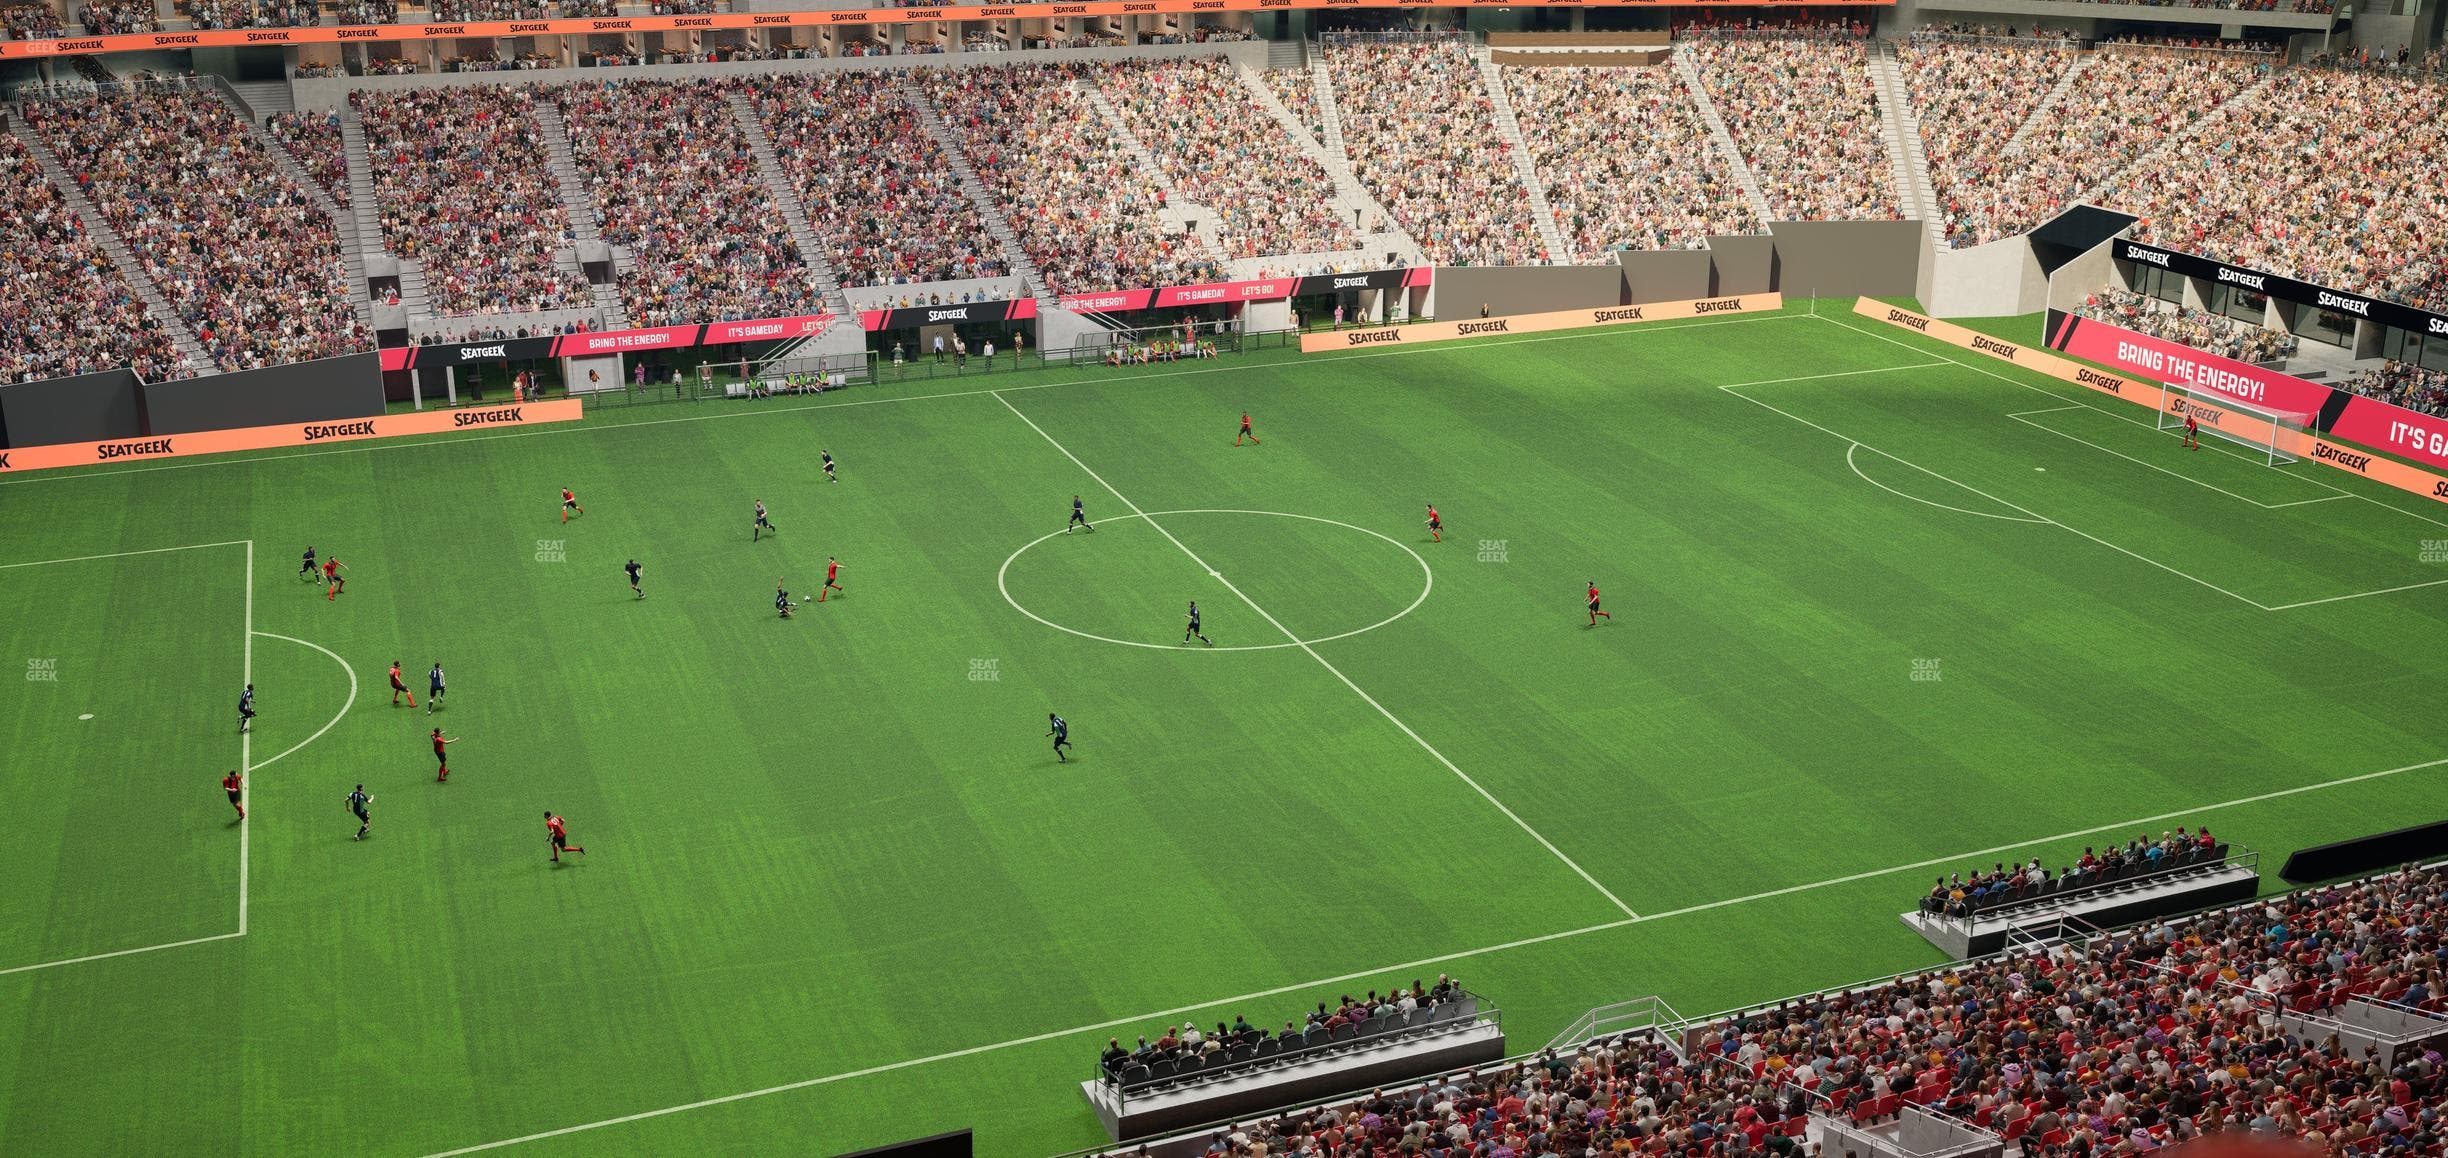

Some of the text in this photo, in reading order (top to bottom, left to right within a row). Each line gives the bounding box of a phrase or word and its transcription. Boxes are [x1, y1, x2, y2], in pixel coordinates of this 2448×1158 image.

[980, 8, 1015, 16] SEATGEEK
[1053, 5, 1087, 13] SEATGEEK
[1123, 3, 1157, 11] SEATGEEK
[1192, 1, 1225, 9] SEATGEEK
[753, 15, 791, 24] SEATGEEK
[831, 13, 867, 21] SEATGEEK
[906, 10, 942, 19] SEATGEEK
[509, 23, 550, 33] SEATGEEK
[593, 20, 632, 30] SEATGEEK
[674, 18, 712, 27] SEATGEEK
[247, 31, 290, 42] SEATGEEK
[336, 28, 379, 39] SEATGEEK
[424, 26, 465, 36] SEATGEEK
[57, 40, 104, 51] SEATGEEK
[154, 34, 199, 46] SEATGEEK
[2128, 245, 2171, 268] SEATGEEK
[1333, 275, 1369, 289] SEATGEEK
[2217, 267, 2265, 291] SEATGEEK
[1177, 284, 1274, 301] IT'S GAMEDAY LET'S GO!
[1095, 296, 1127, 308] ENERGY!
[1694, 298, 1742, 314] SEATGEEK
[2317, 291, 2370, 317] SEATGEEK
[928, 307, 968, 322] SEATGEEK
[1594, 307, 1643, 323] SEATGEEK
[1887, 309, 1930, 332] SEATGEEK
[728, 327, 744, 338] IT'S
[745, 324, 784, 336] GAMEDAY
[1457, 319, 1508, 336] SEATGEEK
[589, 333, 670, 349] BRING THE ENERGY!
[1348, 328, 1401, 345] SEATGEEK
[460, 344, 506, 360] SEATGEEK
[1971, 335, 2018, 360] SEATGEEK
[2117, 341, 2265, 402] BRING THE ENERGY!
[2076, 368, 2123, 394] SEATGEEK
[454, 406, 523, 427] SEATGEEK
[303, 420, 376, 441] SEATGEEK
[2389, 420, 2426, 450] IT'S
[97, 438, 174, 460] SEATGEEK
[2310, 441, 2371, 473] SEATGEEK
